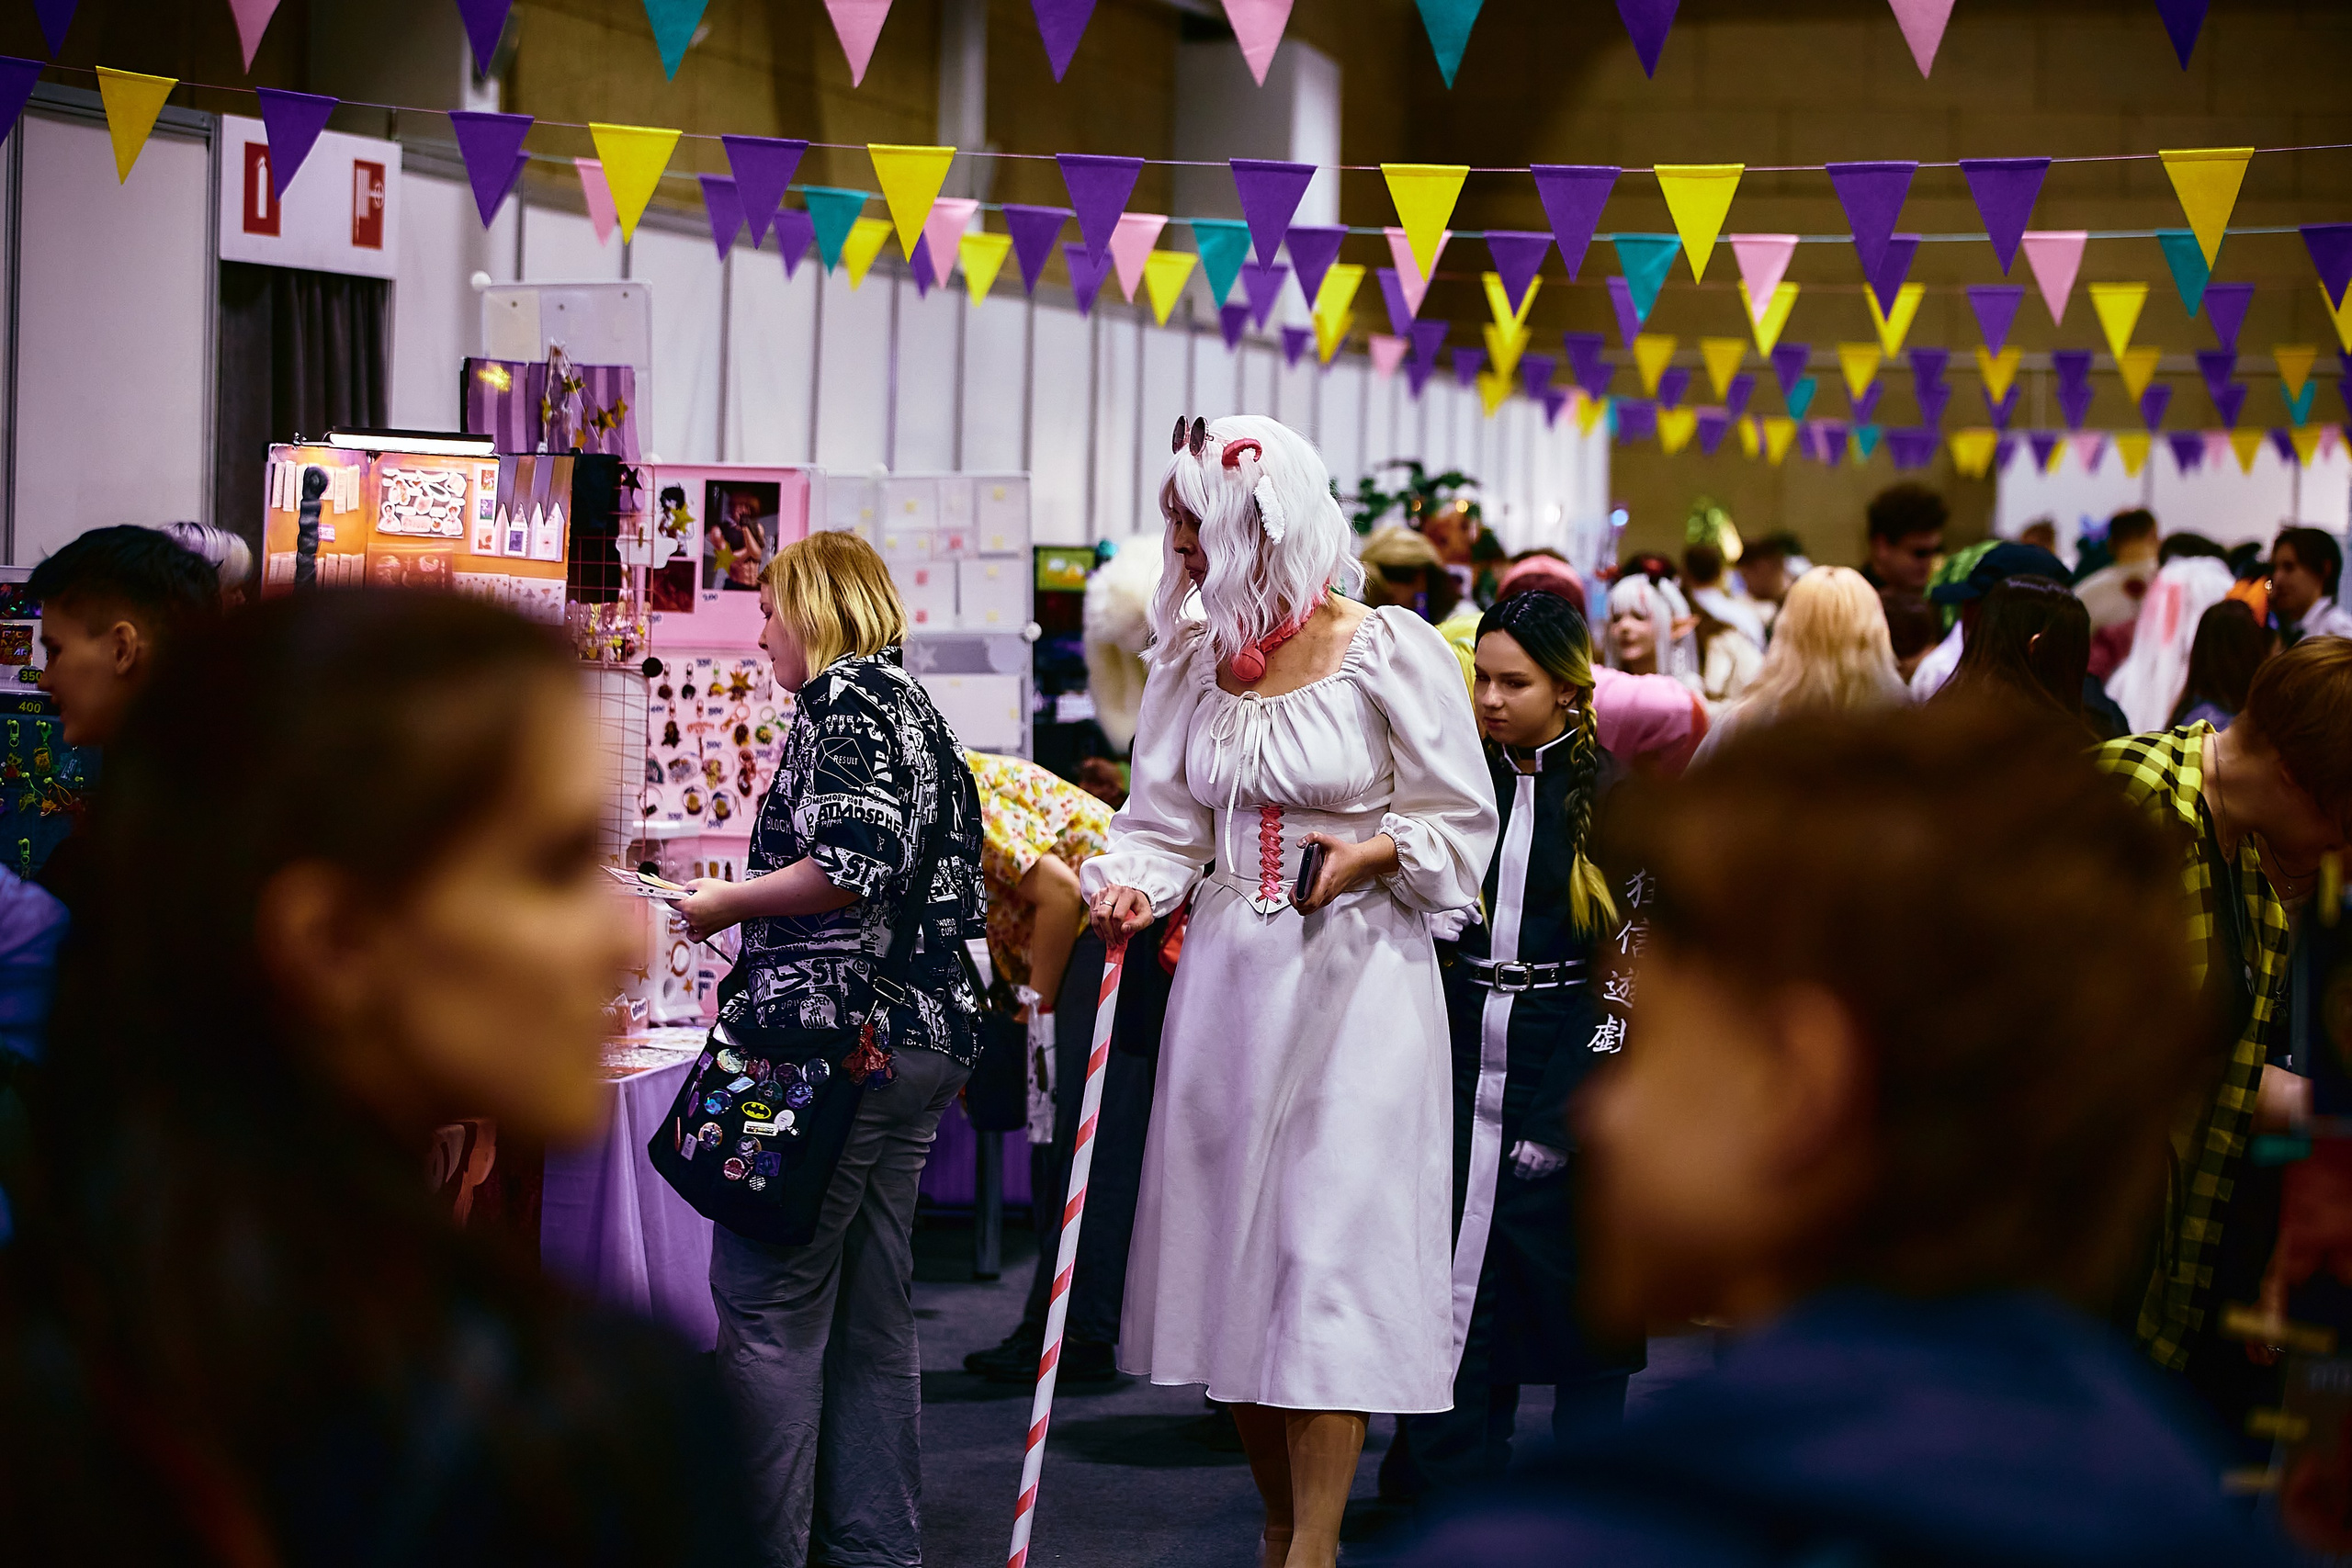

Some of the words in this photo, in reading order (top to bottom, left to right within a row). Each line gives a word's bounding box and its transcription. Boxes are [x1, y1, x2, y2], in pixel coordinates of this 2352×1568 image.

[22, 671, 42, 681] 350
[19, 702, 41, 713] 400
[833, 754, 859, 766] RESULT
[813, 794, 845, 806] MEMORY
